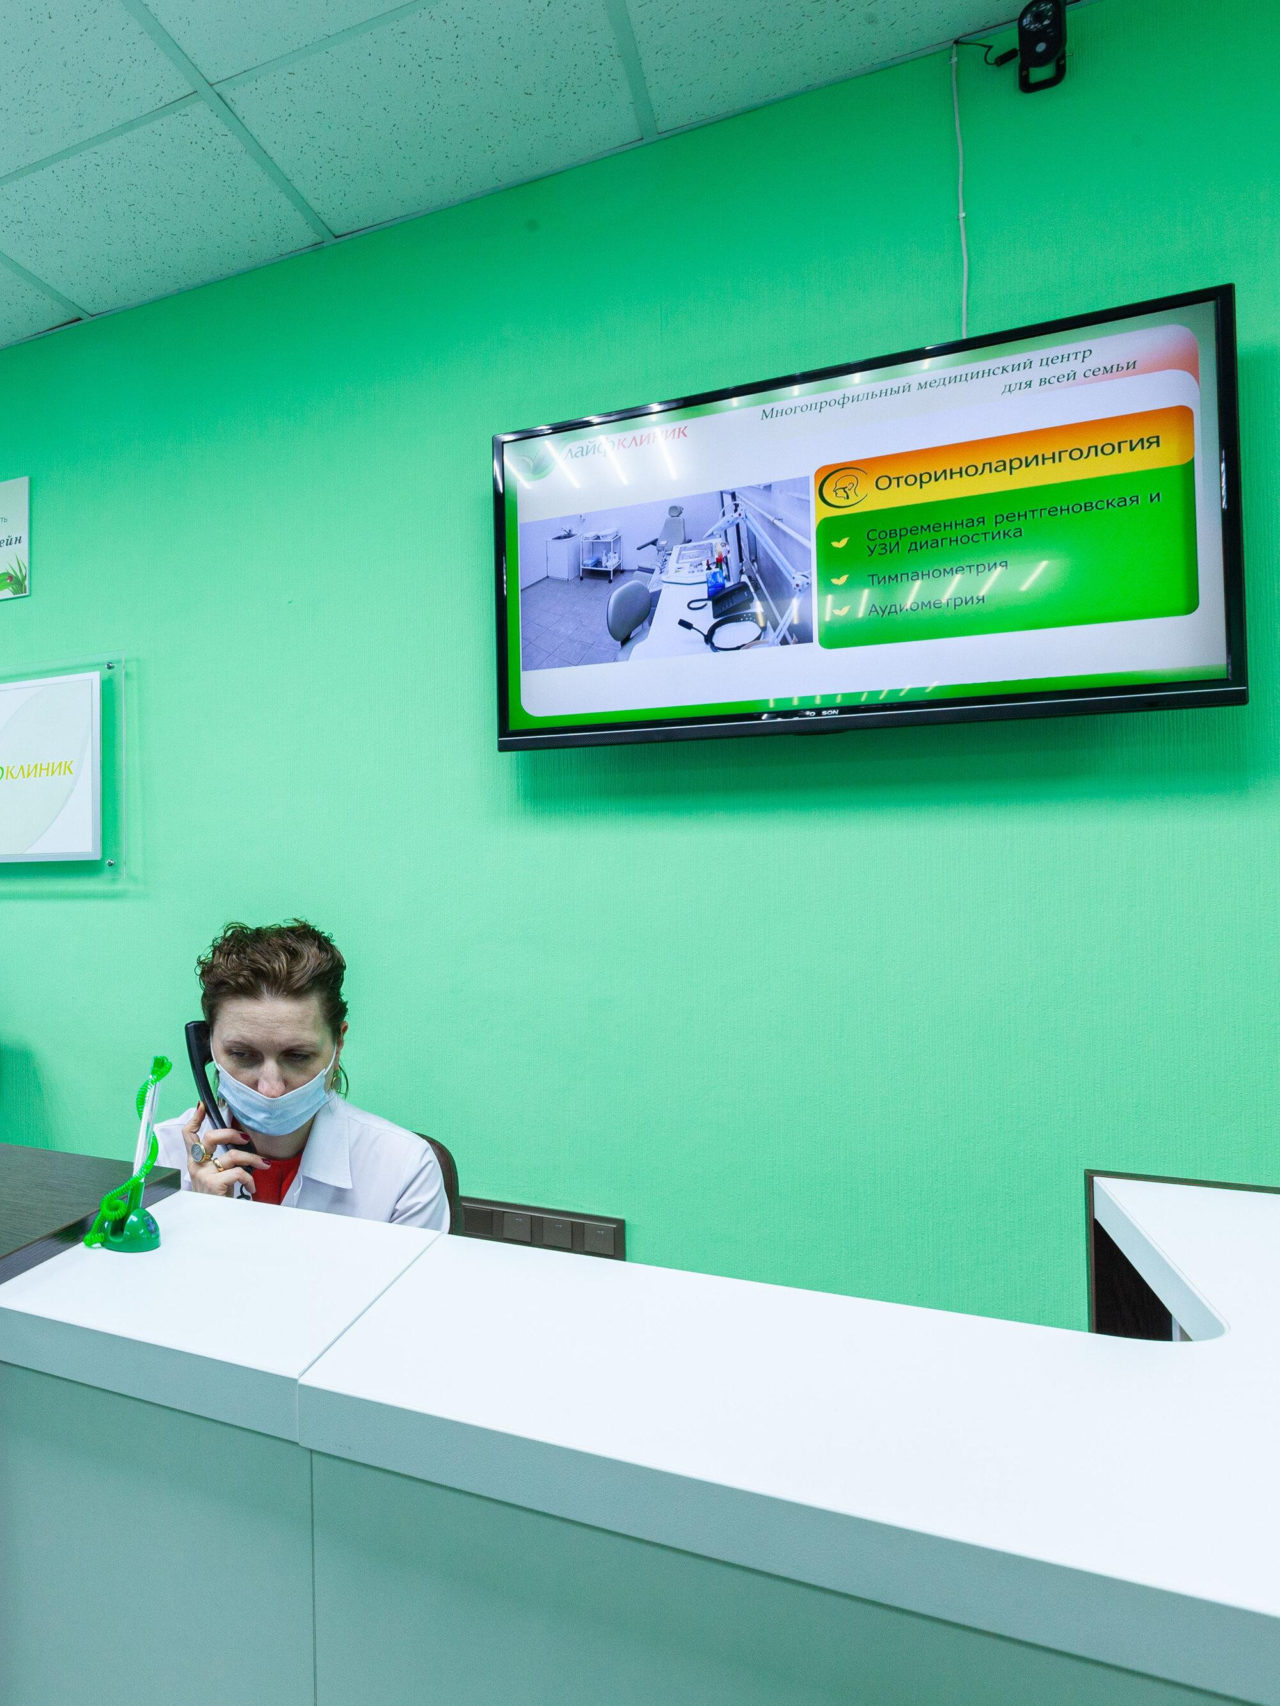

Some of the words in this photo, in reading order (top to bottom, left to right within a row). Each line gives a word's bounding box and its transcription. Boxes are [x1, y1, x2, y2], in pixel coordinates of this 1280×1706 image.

[760, 382, 911, 421] Многопрофильный
[917, 358, 1033, 391] медицинский
[1039, 348, 1093, 368] центр
[1001, 379, 1032, 396] для
[1038, 368, 1077, 388] всей
[1082, 359, 1139, 379] семьи
[875, 434, 1161, 491] Оториноларингология
[866, 513, 985, 542] Современная
[994, 493, 1140, 527] рентгеновская
[1149, 490, 1162, 504] и
[866, 541, 901, 557] УЗИ
[908, 526, 1023, 554] диагностика
[867, 560, 1008, 586] Тимпанометрия
[868, 594, 985, 618] Аудиометрия
